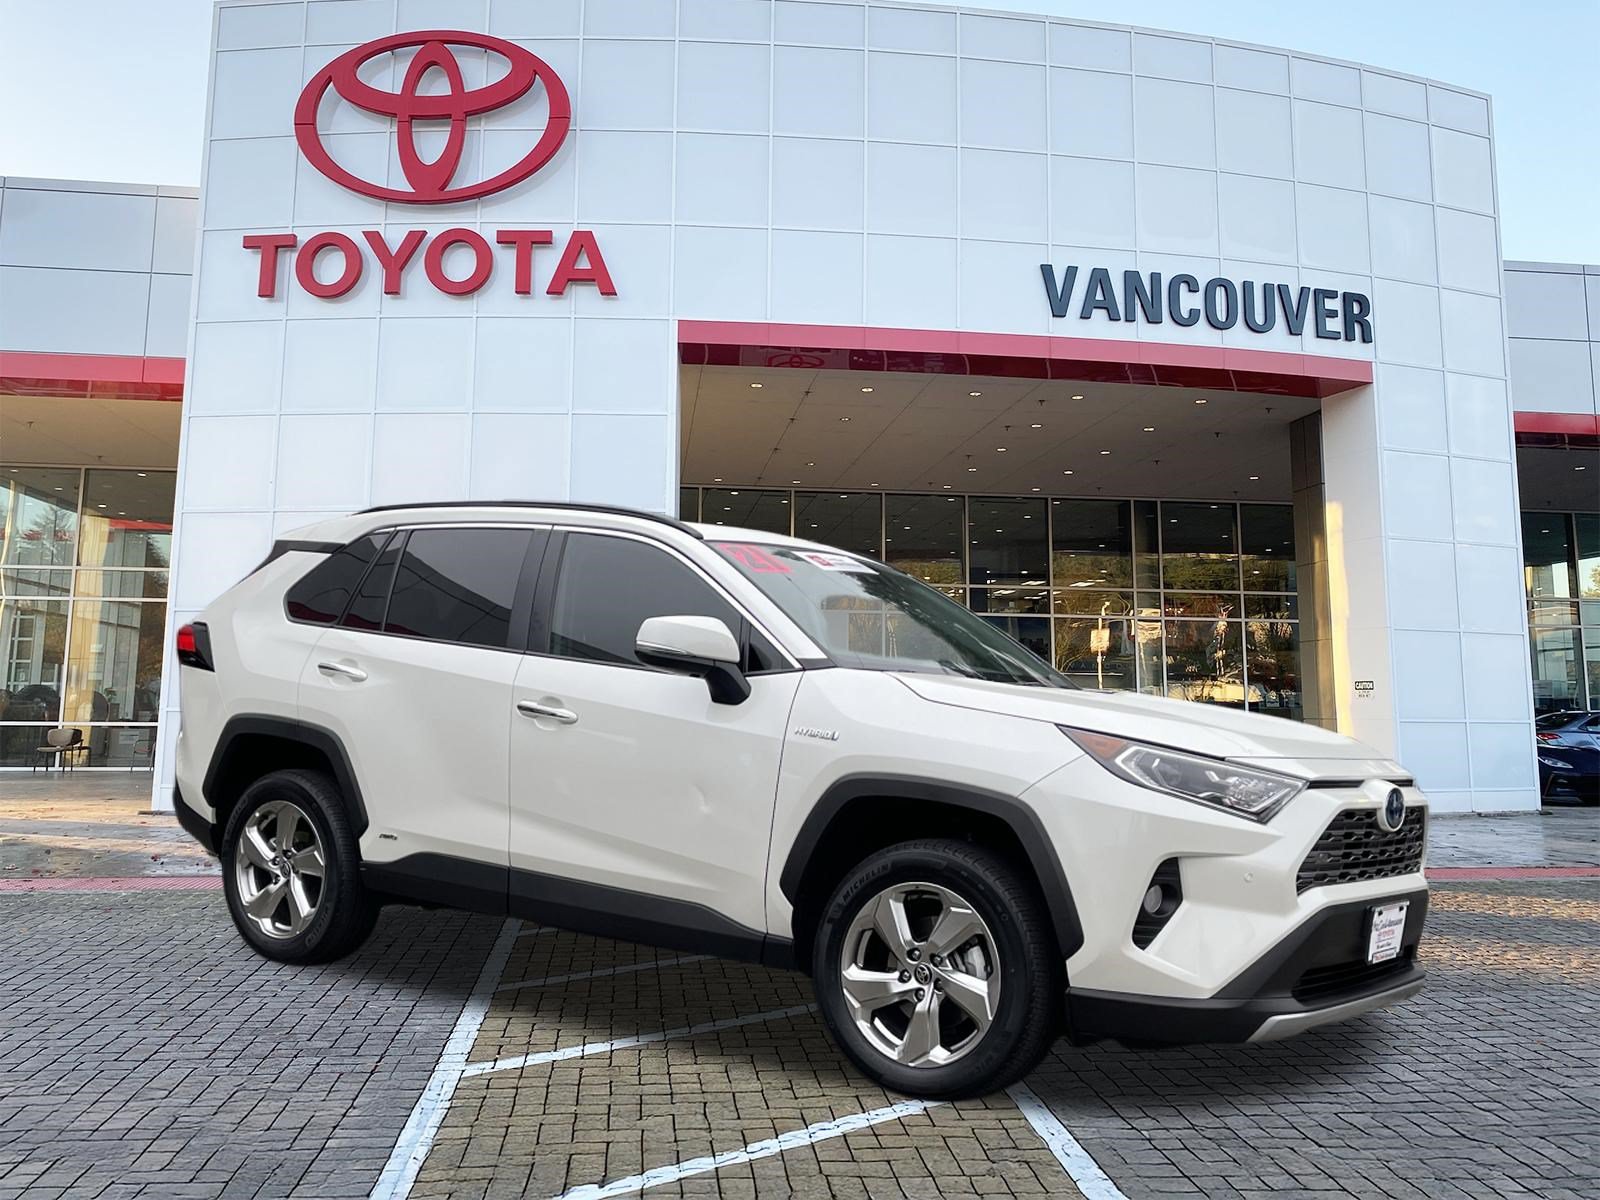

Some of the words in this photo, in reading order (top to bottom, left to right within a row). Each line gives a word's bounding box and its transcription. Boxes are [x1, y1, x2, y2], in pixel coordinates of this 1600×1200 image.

[242, 228, 618, 299] TOYOTA
[1040, 263, 1373, 344] VANCOUVER
[794, 727, 832, 740] HYBRID
[842, 863, 889, 903] MICHELIN
